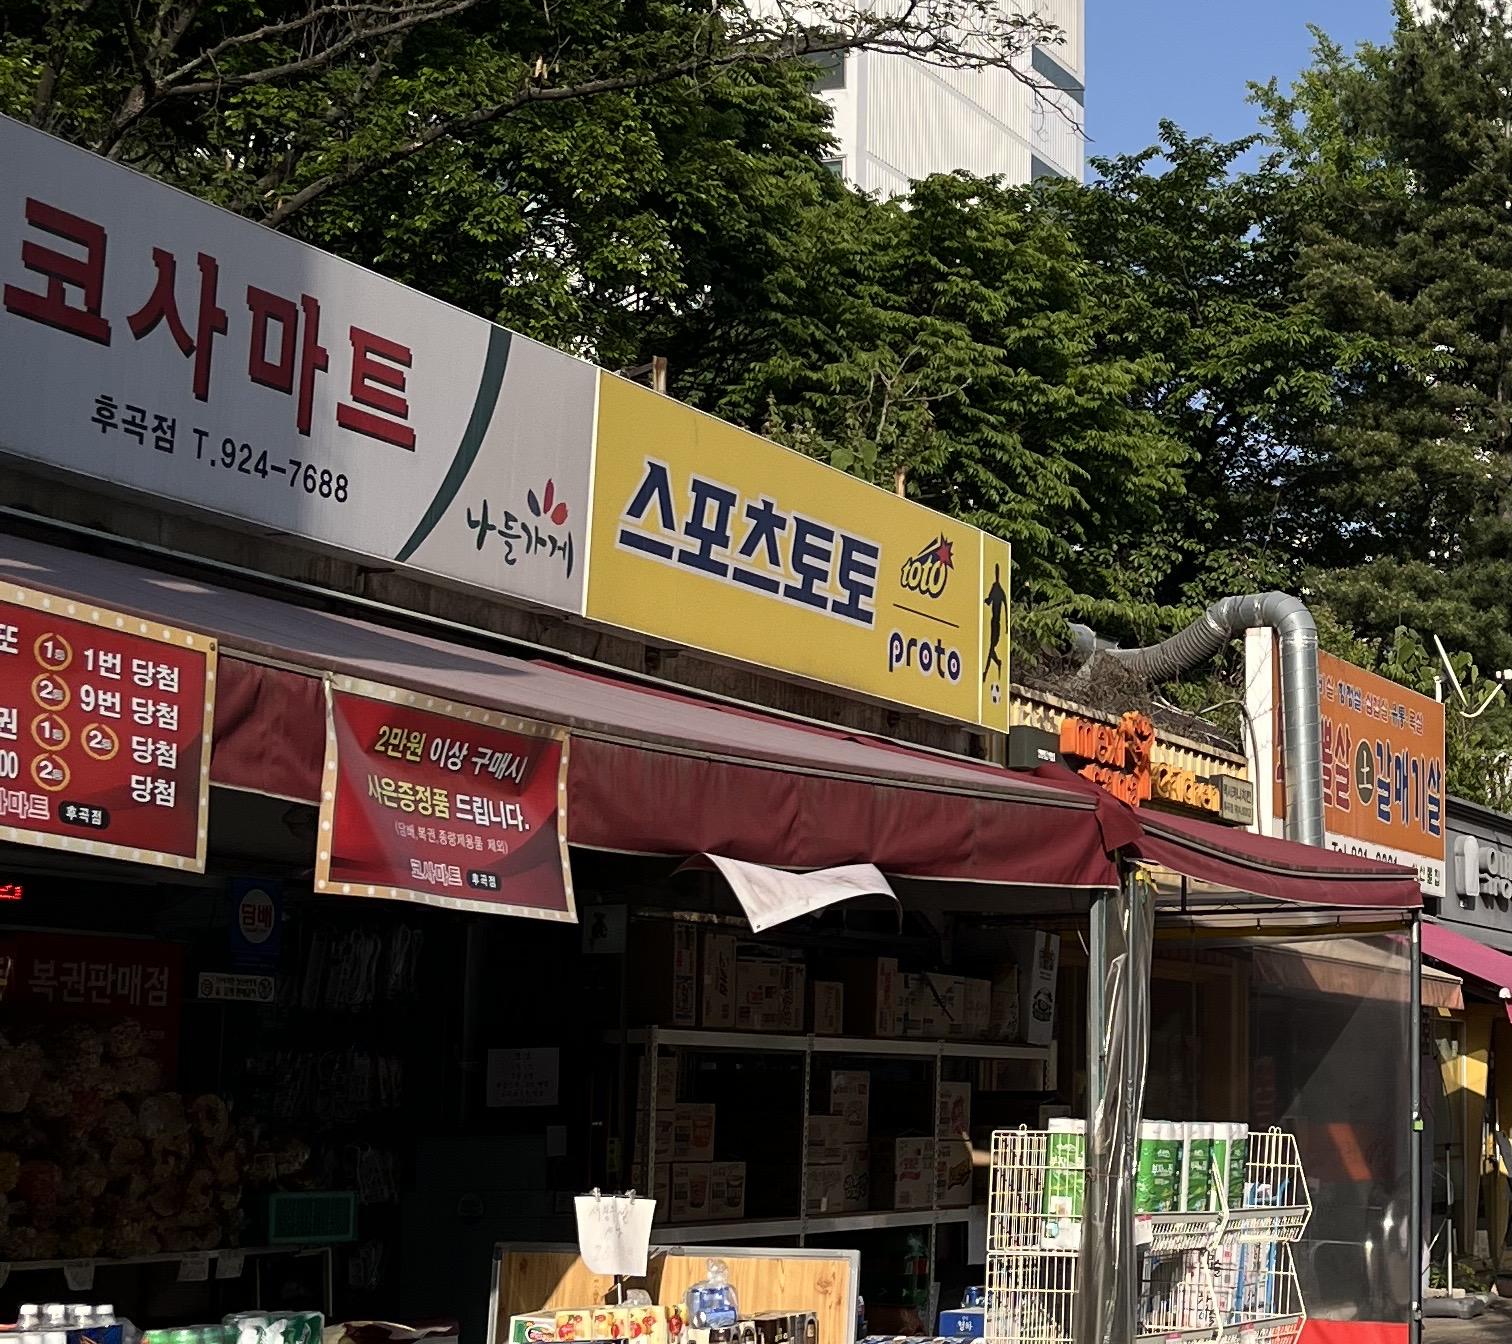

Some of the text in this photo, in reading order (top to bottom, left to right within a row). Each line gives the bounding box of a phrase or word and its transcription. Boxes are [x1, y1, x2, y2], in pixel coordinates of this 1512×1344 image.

[3, 196, 418, 452] 코사마트
[90, 394, 350, 503] 후곡점 T.924-7688
[466, 498, 575, 579] 나들가게
[617, 458, 881, 626] 스포츠토토
[899, 546, 951, 599] toto
[84, 648, 121, 680] 1번
[132, 658, 180, 693] 당첨
[889, 632, 961, 685] proto
[80, 684, 121, 718] 9번
[132, 697, 179, 731] 당첨
[131, 736, 178, 769] 당첨
[375, 725, 528, 783] 2만원 이상 구매시
[131, 774, 176, 807] 당첨
[368, 775, 530, 832] 사은증정품 드립니다.
[1376, 738, 1441, 838] 갈매기살
[66, 805, 102, 826] 후곡점
[410, 859, 463, 886] 코사마트
[241, 903, 274, 932] 담배
[28, 958, 170, 1008] 복권판매점
